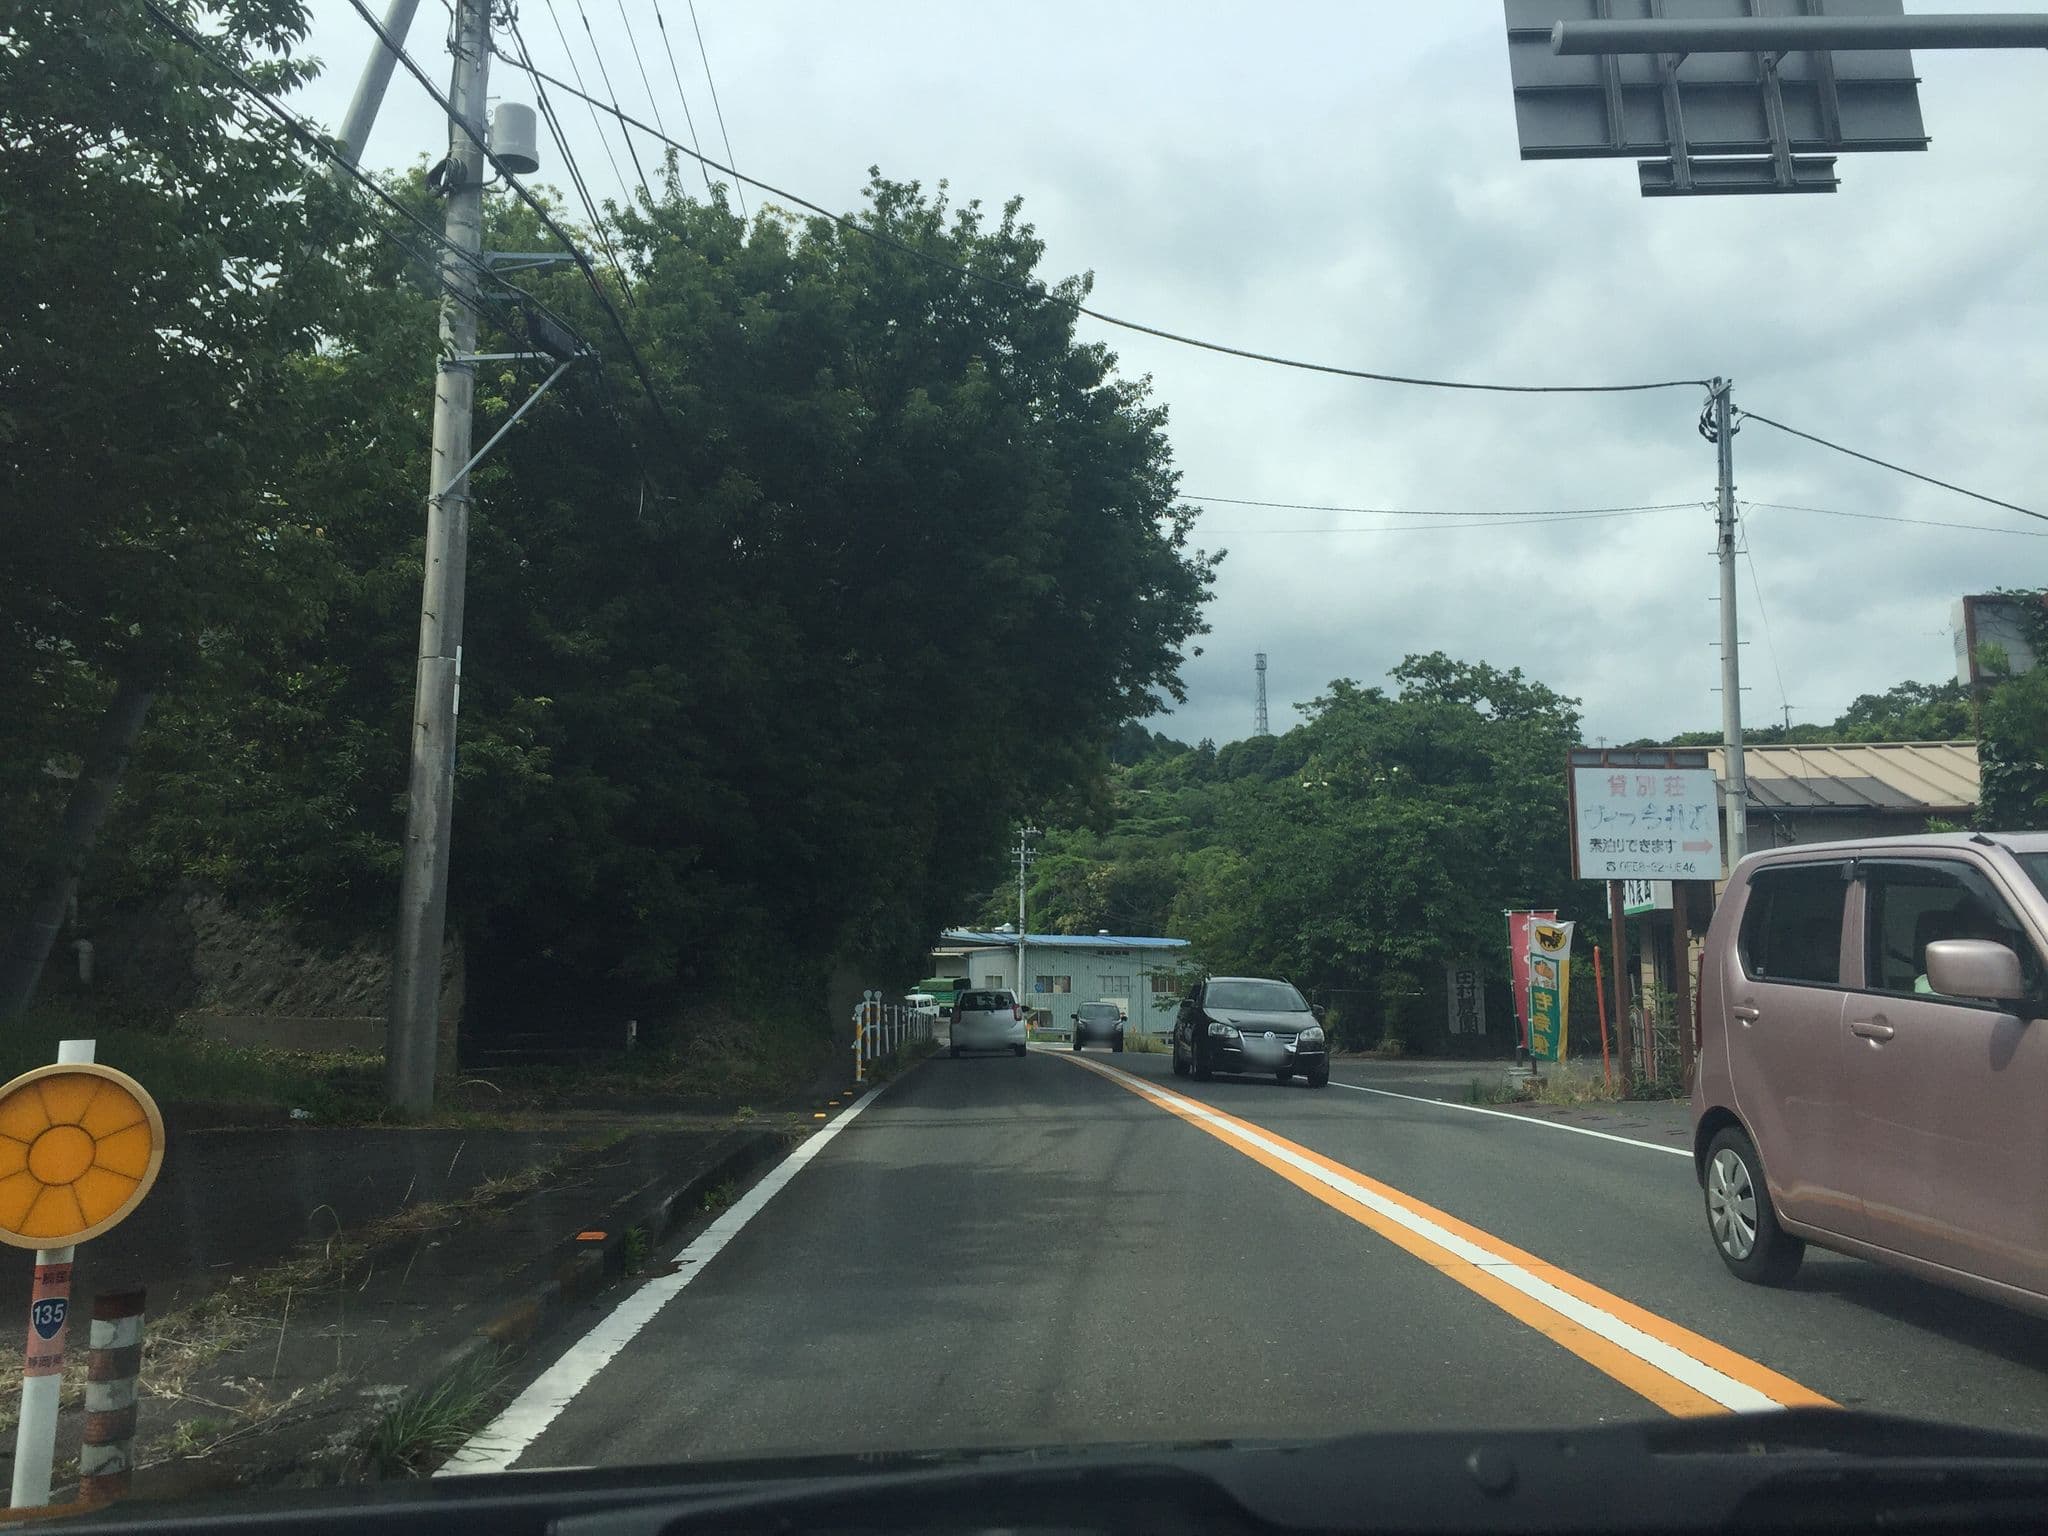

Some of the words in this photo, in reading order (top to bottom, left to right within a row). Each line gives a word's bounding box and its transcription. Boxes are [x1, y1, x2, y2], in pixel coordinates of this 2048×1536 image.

[1608, 774, 1685, 798] 貸別荘
[1589, 838, 1677, 854] 素泊りできます
[34, 1303, 64, 1325] 135
